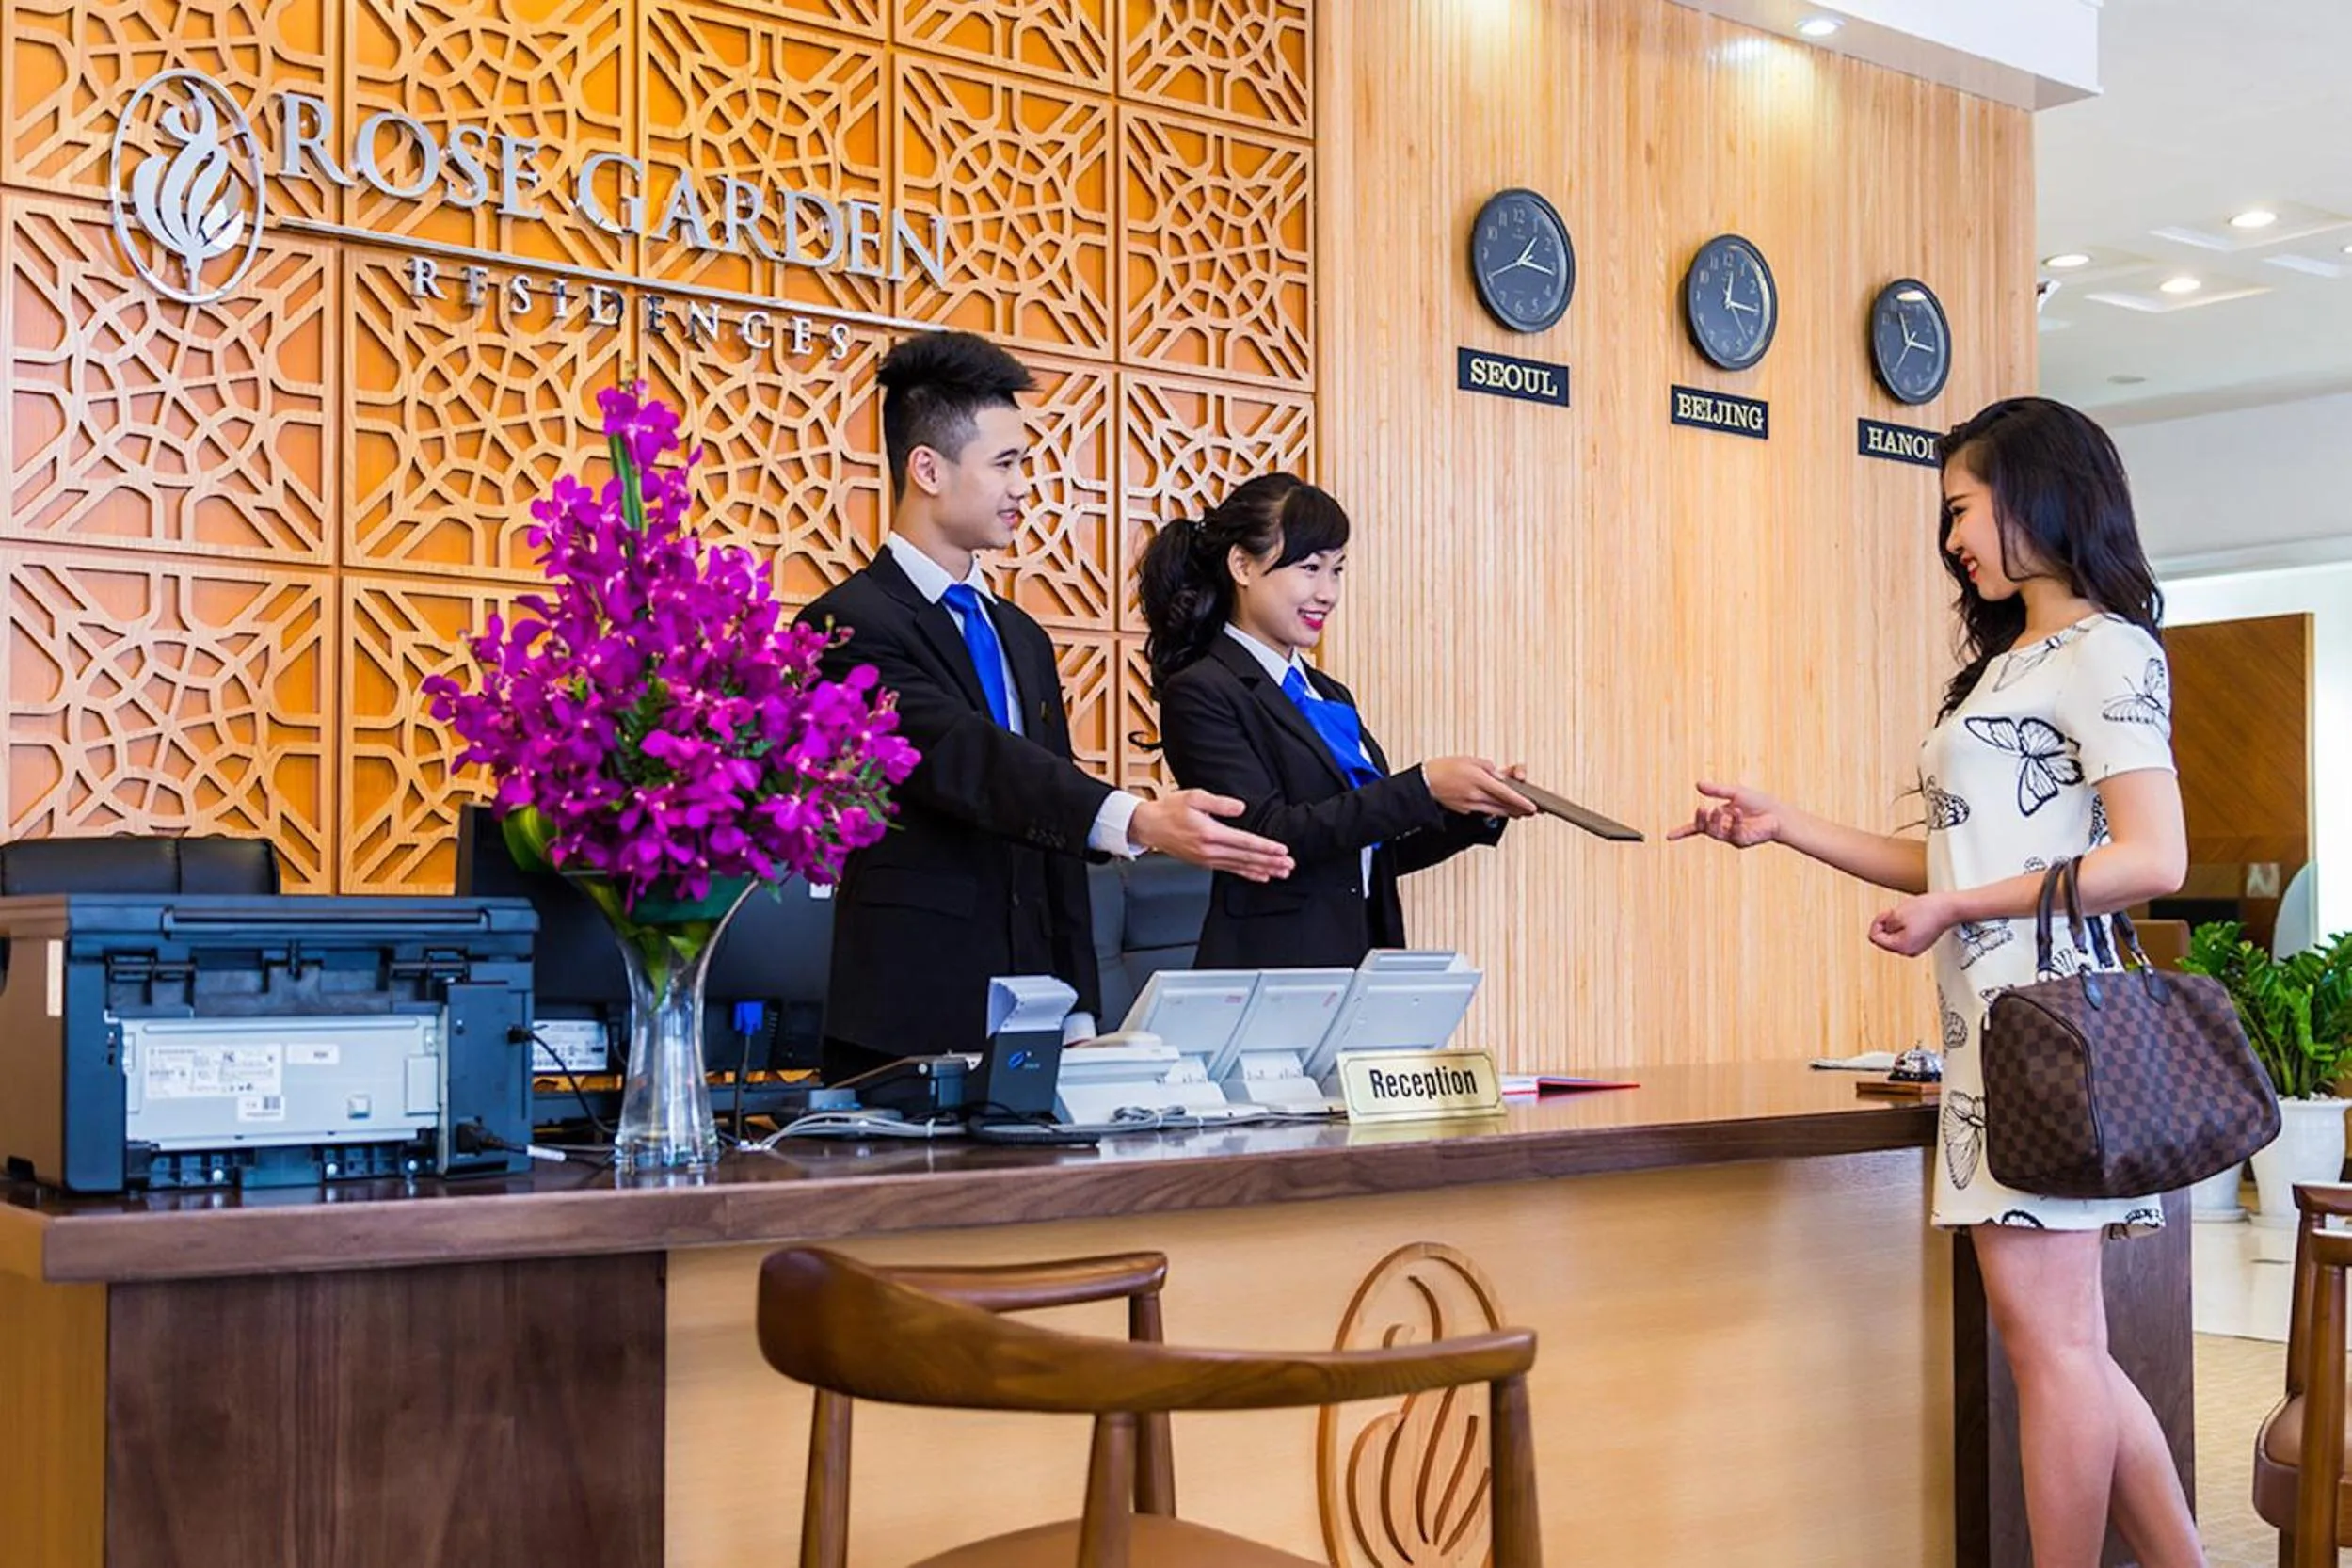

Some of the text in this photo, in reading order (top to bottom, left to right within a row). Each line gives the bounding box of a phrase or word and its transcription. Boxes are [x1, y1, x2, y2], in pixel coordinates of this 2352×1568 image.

[270, 93, 947, 287] ROSE GARDEN
[404, 256, 850, 360] RESIDENCES
[1469, 357, 1558, 397] SEOUL
[1676, 392, 1764, 430] BEIJING
[1867, 426, 1935, 460] HANOI
[1368, 1065, 1478, 1099] Reception
